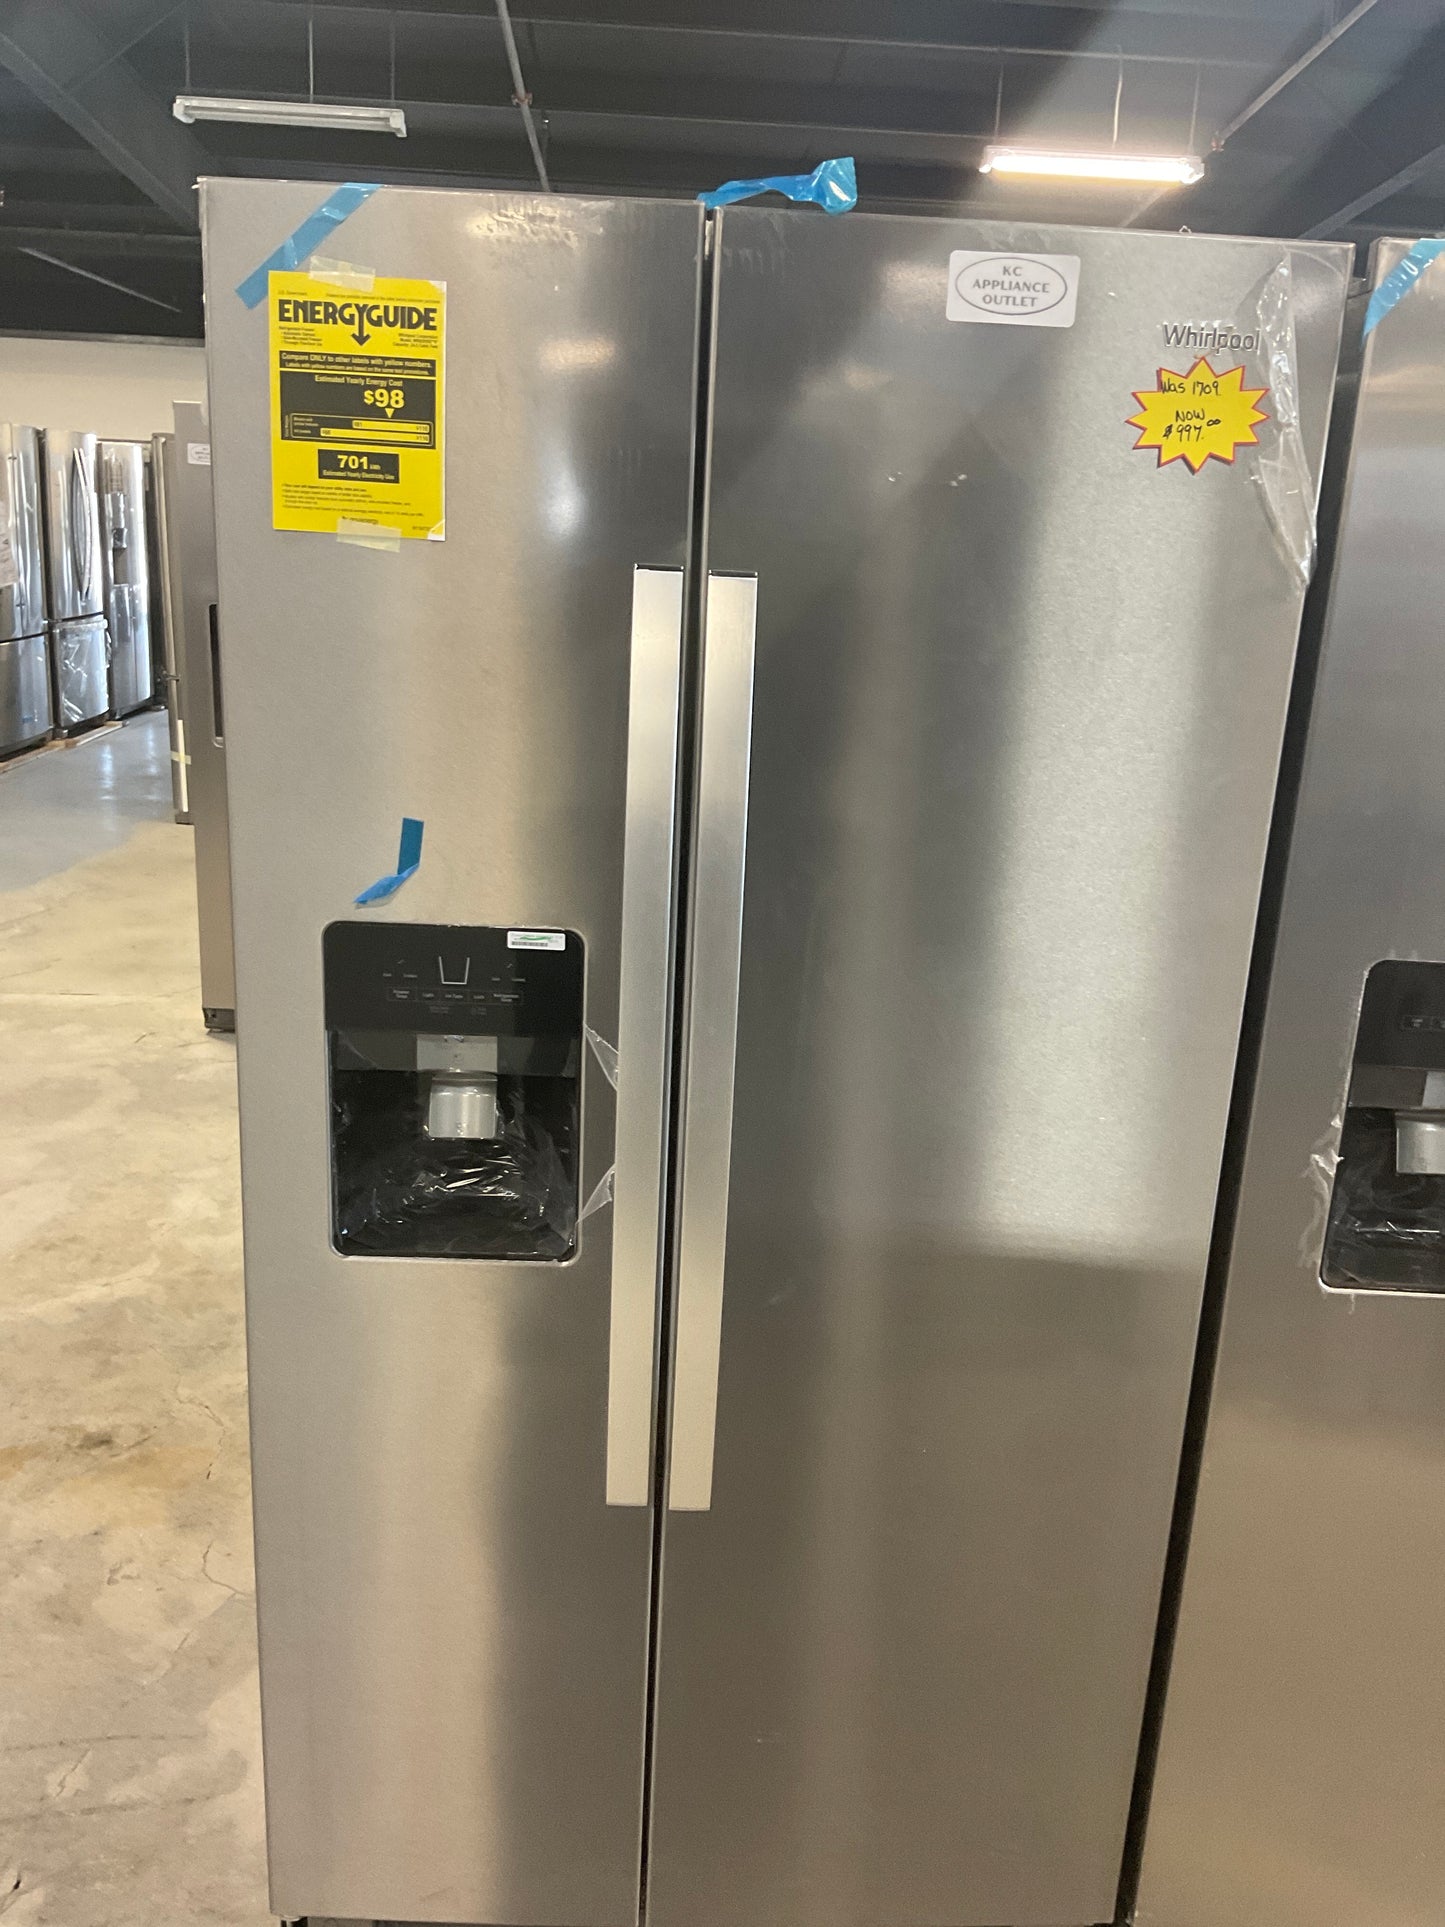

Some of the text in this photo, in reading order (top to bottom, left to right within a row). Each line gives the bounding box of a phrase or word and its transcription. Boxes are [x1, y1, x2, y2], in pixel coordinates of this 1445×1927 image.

[1002, 265, 1023, 277] KC
[972, 279, 1051, 294] APPLIANCE
[982, 294, 1038, 307] OUTLET
[278, 299, 437, 331] ENERGYGUIDE
[1163, 323, 1261, 354] Whirlpool
[281, 352, 309, 362] Compare
[364, 388, 405, 409] $98
[1175, 408, 1206, 423] NOW
[337, 454, 368, 470] 701
